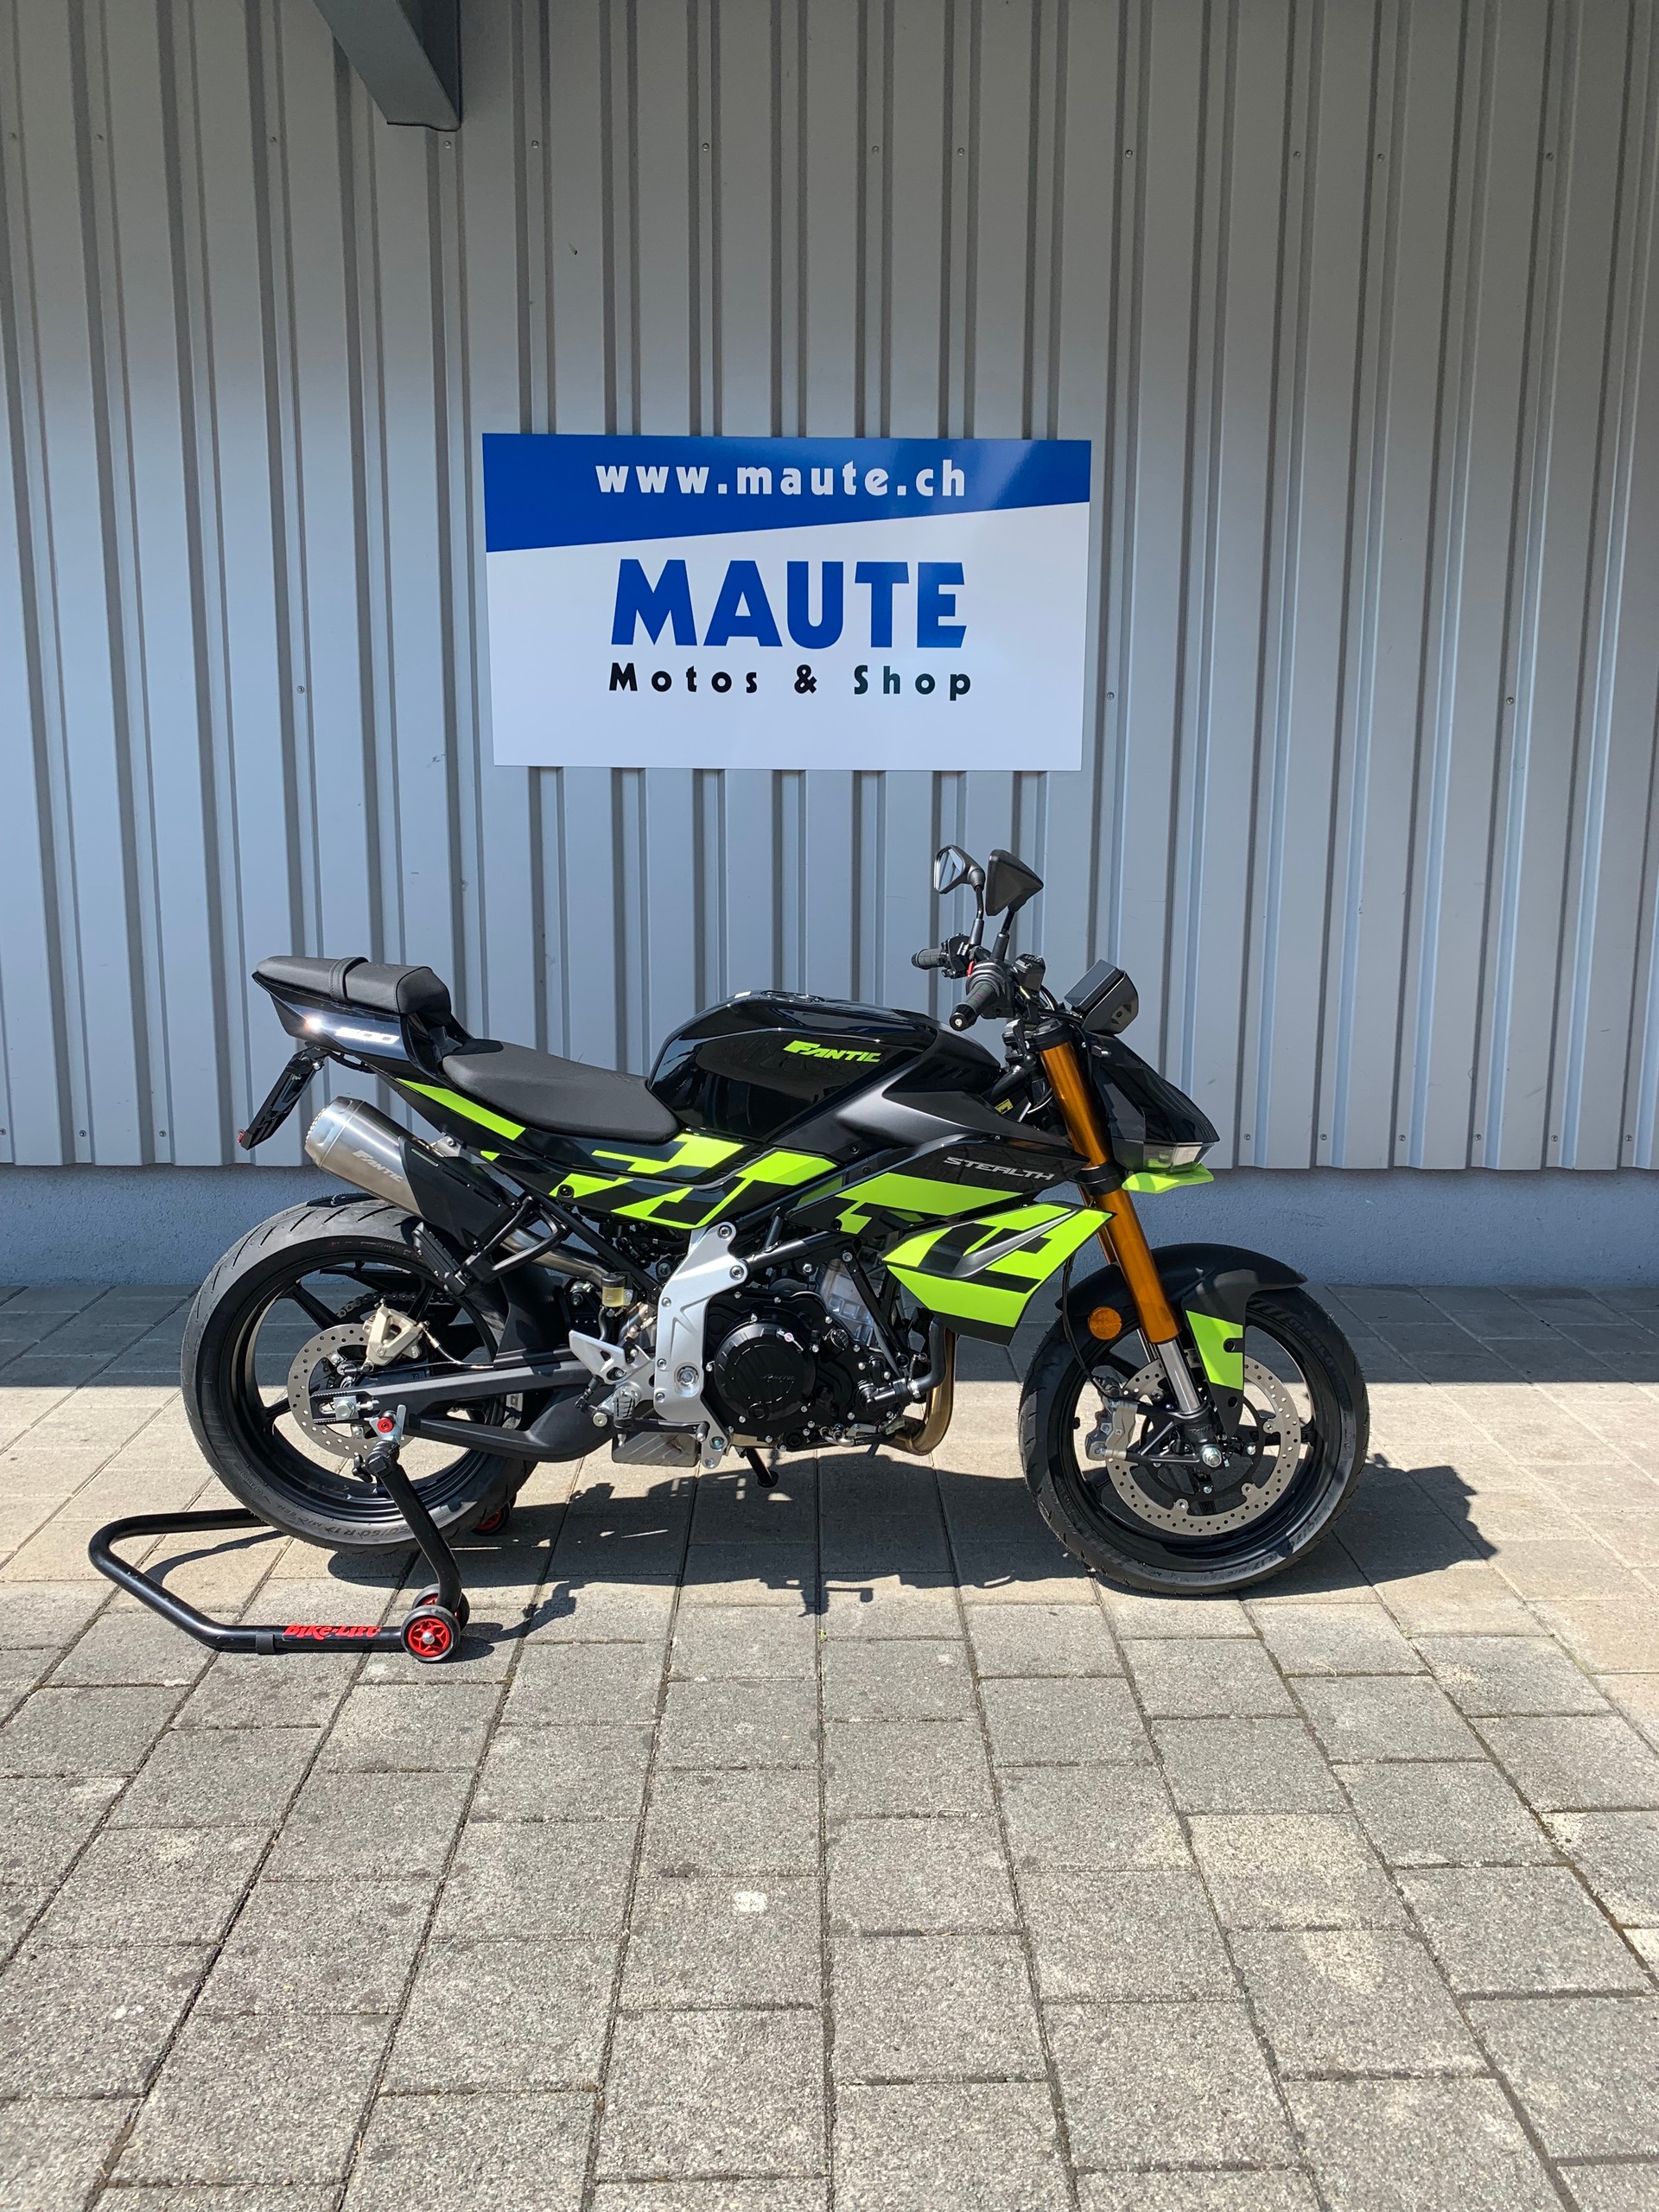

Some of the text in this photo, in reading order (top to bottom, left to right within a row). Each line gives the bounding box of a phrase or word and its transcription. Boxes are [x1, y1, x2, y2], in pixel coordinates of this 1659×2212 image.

[596, 460, 965, 496] www.maute.ch
[611, 559, 966, 649] MAUTE
[609, 663, 970, 701] Motos & Shop
[783, 1039, 881, 1063] FANTIC
[352, 1149, 404, 1183] FANTIC
[943, 1156, 1055, 1180] STEALTH
